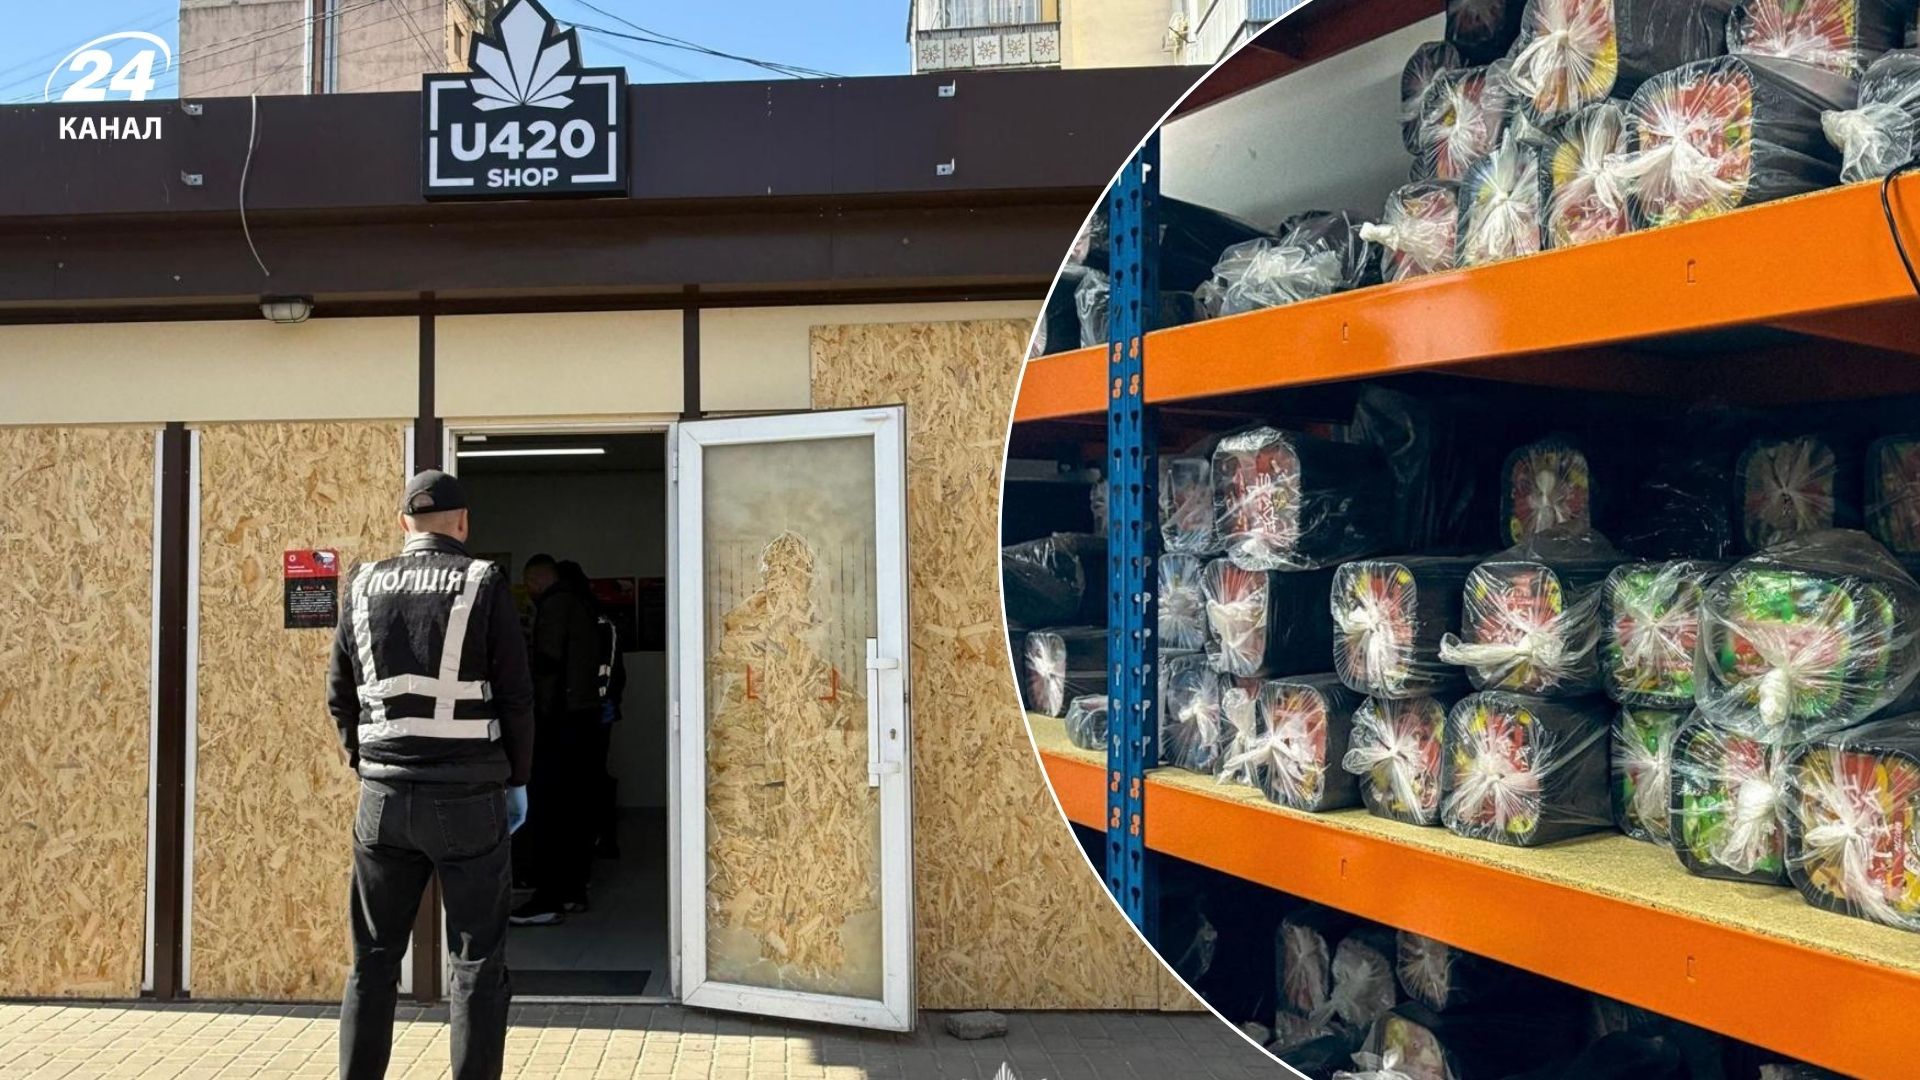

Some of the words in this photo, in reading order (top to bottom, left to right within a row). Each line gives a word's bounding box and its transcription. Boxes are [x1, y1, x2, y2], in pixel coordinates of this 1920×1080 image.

[451, 118, 596, 162] U420
[487, 167, 559, 188] SHOP
[367, 568, 465, 595] ПОЛІЦІЯ
